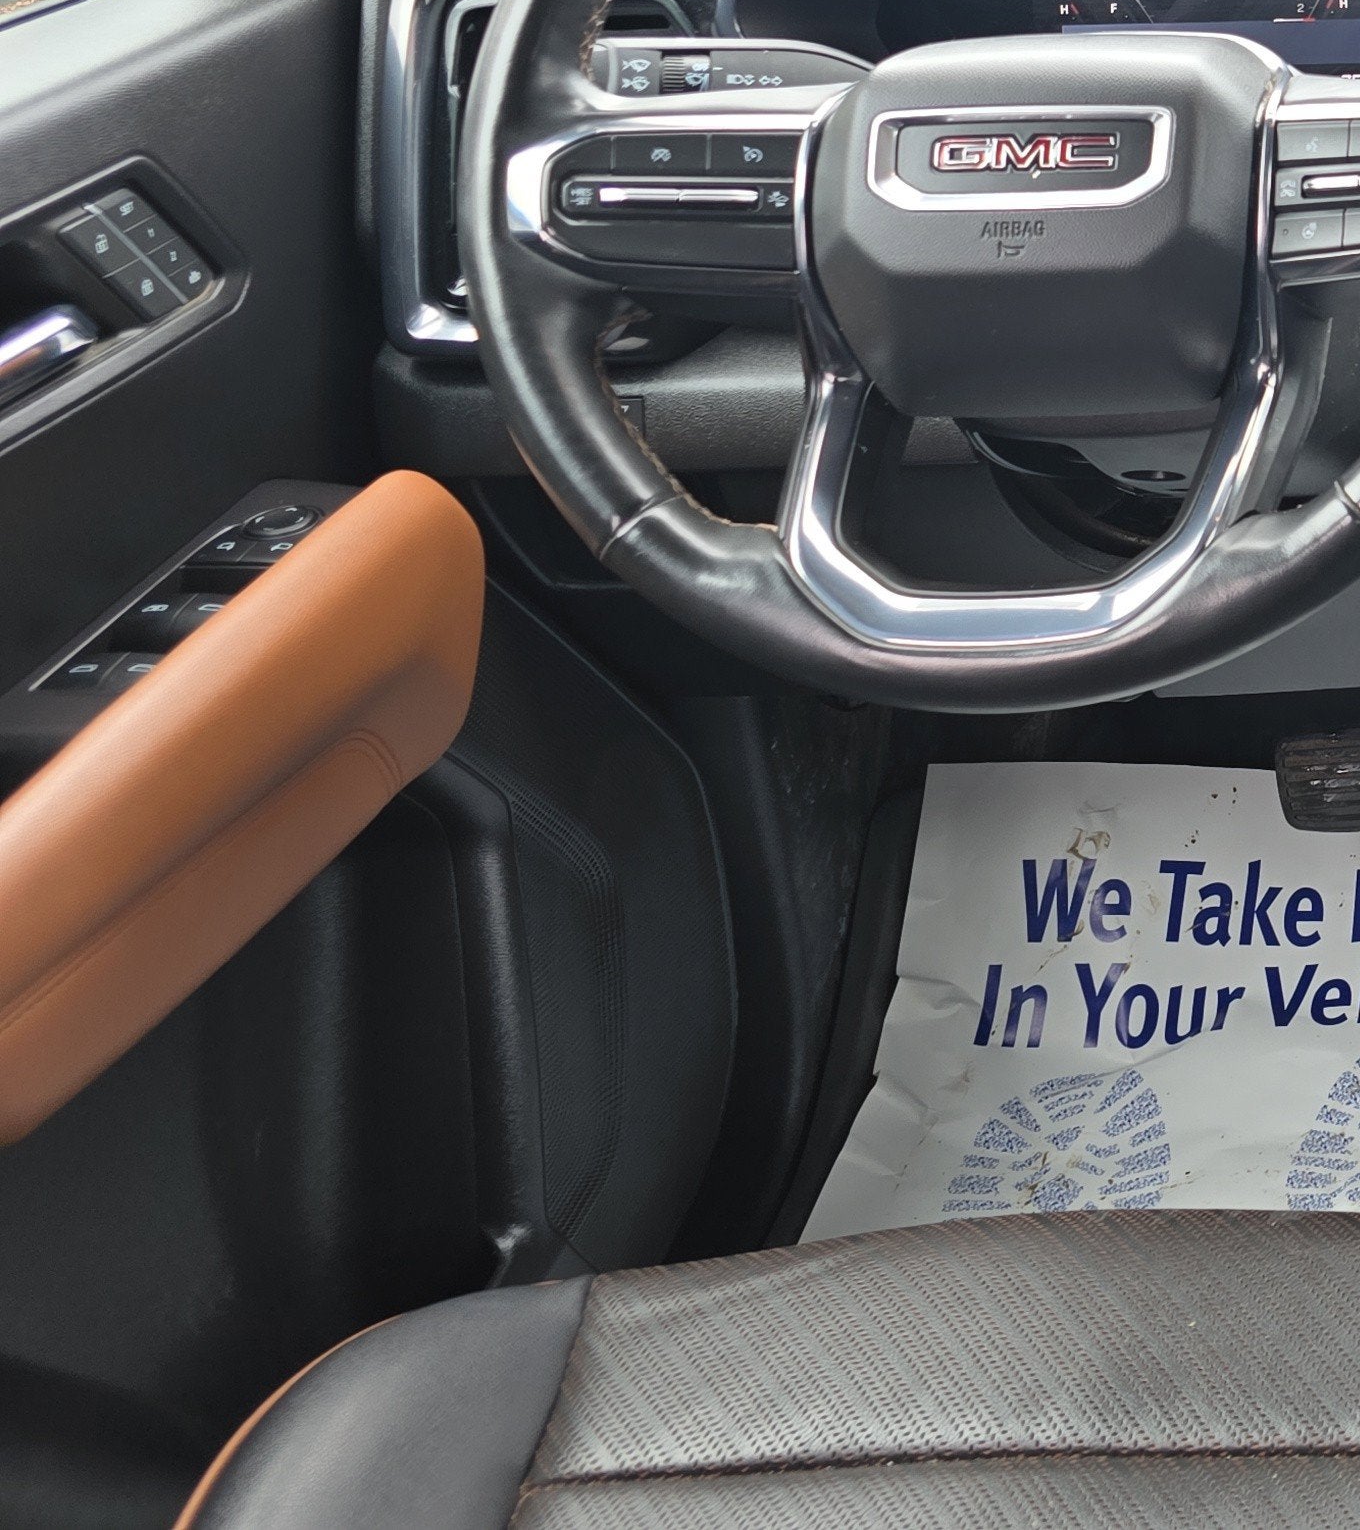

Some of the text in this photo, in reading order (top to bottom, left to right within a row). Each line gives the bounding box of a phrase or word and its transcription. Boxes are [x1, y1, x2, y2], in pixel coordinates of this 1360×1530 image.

[1060, 4, 1069, 15] H
[1110, 2, 1118, 14] F
[1296, 3, 1305, 13] 2
[932, 134, 1118, 171] GMC
[980, 220, 1046, 238] AIRBAG
[1022, 858, 1133, 945] We
[1158, 858, 1326, 949] Take
[973, 963, 1050, 1049] In
[1073, 962, 1247, 1050] Your
